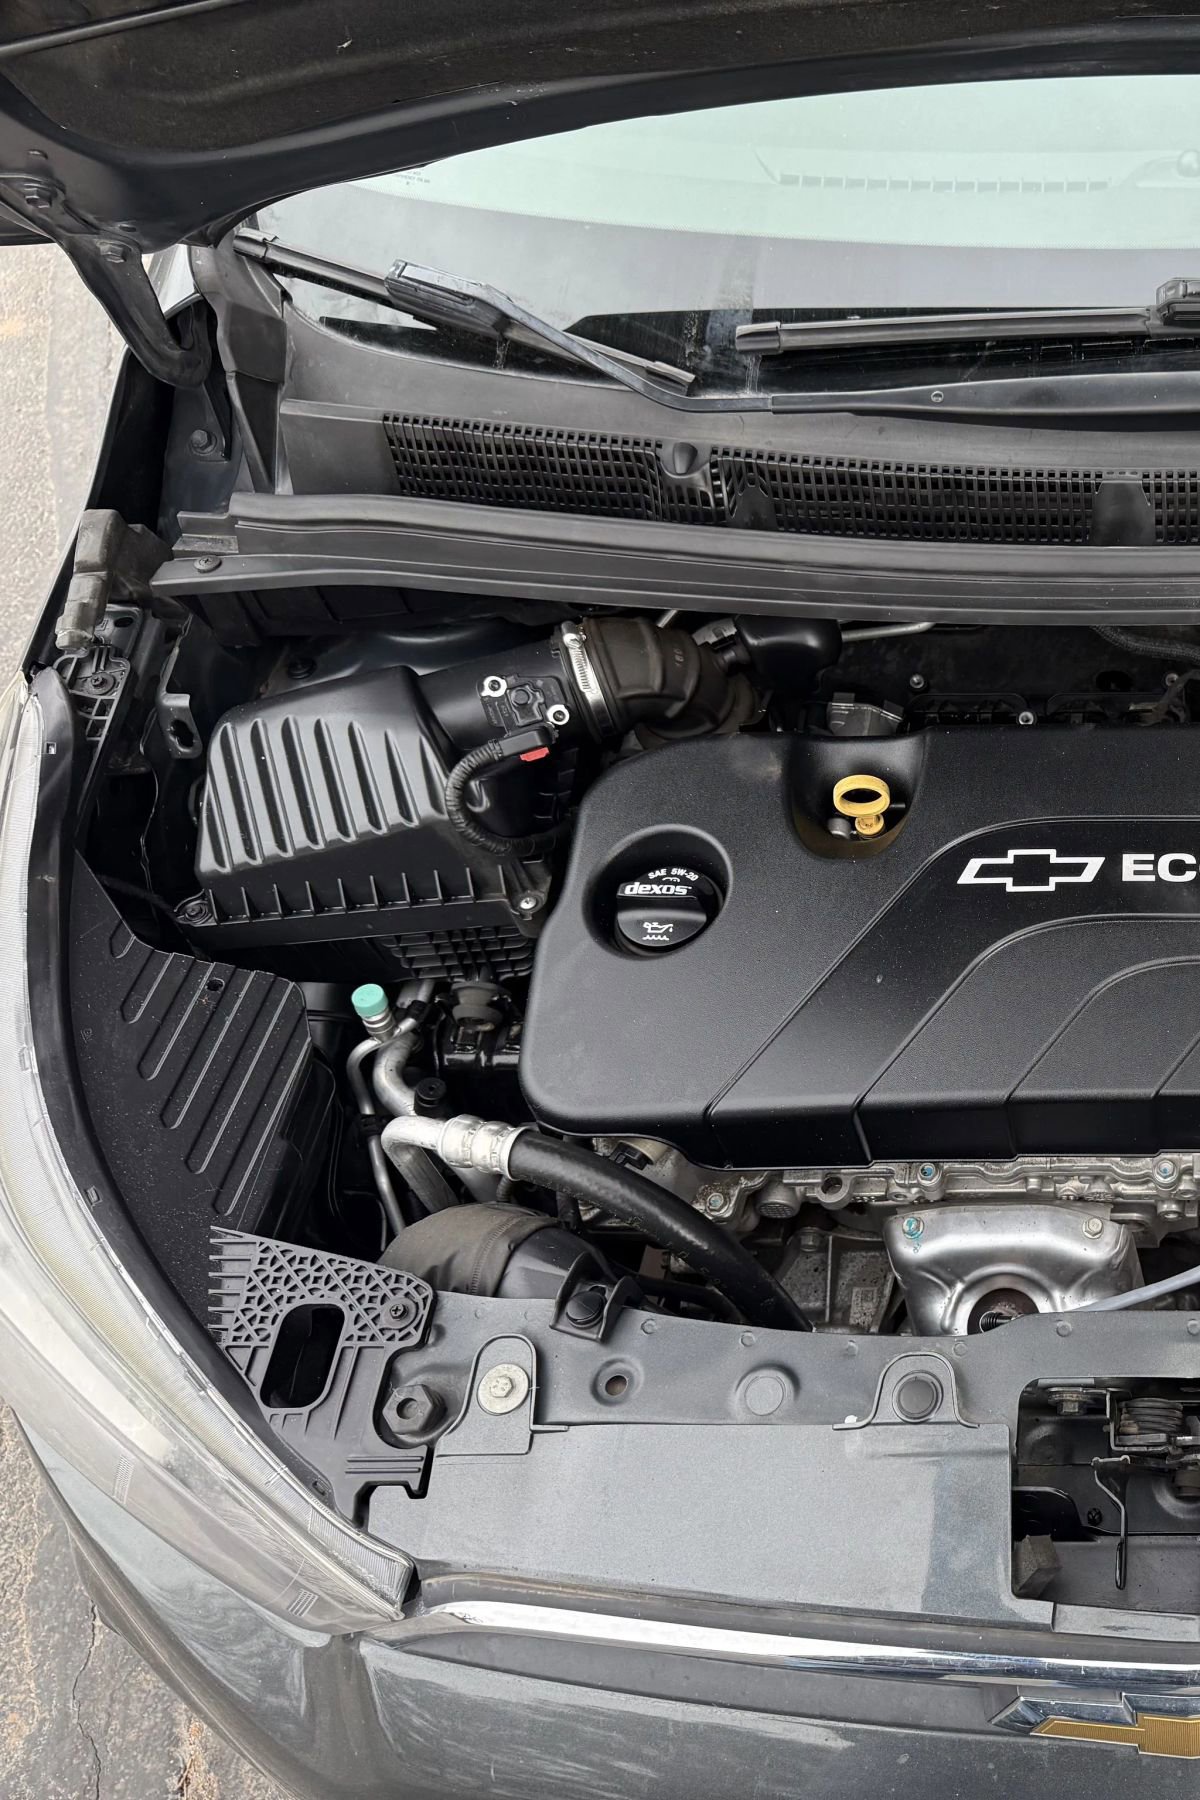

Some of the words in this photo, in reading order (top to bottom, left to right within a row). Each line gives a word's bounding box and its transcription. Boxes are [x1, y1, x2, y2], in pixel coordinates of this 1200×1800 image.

[648, 868, 667, 879] SAE
[671, 868, 699, 881] 5W-20
[624, 882, 692, 895] dexos
